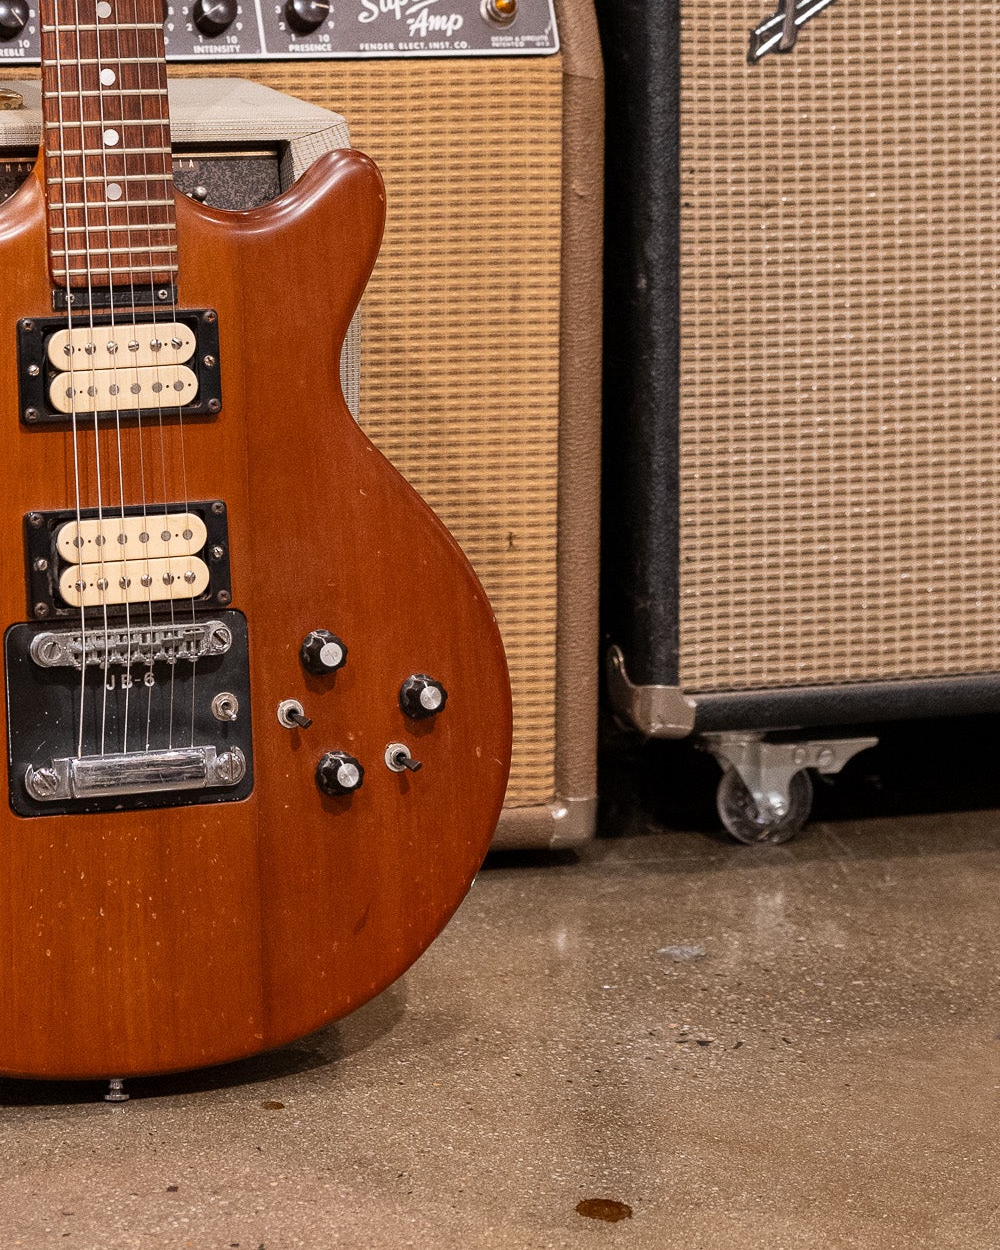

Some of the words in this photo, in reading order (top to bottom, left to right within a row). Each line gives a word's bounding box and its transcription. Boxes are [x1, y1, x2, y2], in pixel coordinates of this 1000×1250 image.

[182, 6, 189, 15] 3
[275, 5, 282, 14] 3
[186, 23, 193, 32] 2
[279, 21, 286, 31] 2
[406, 8, 464, 38] Amp
[198, 34, 203, 43] 1
[226, 35, 238, 44] 10
[291, 33, 296, 42] 1
[318, 34, 330, 43] 10
[18, 40, 30, 48] 10
[288, 43, 332, 52] PRESENCE
[359, 42, 395, 51] FENDER
[193, 44, 241, 54] INTENSITY
